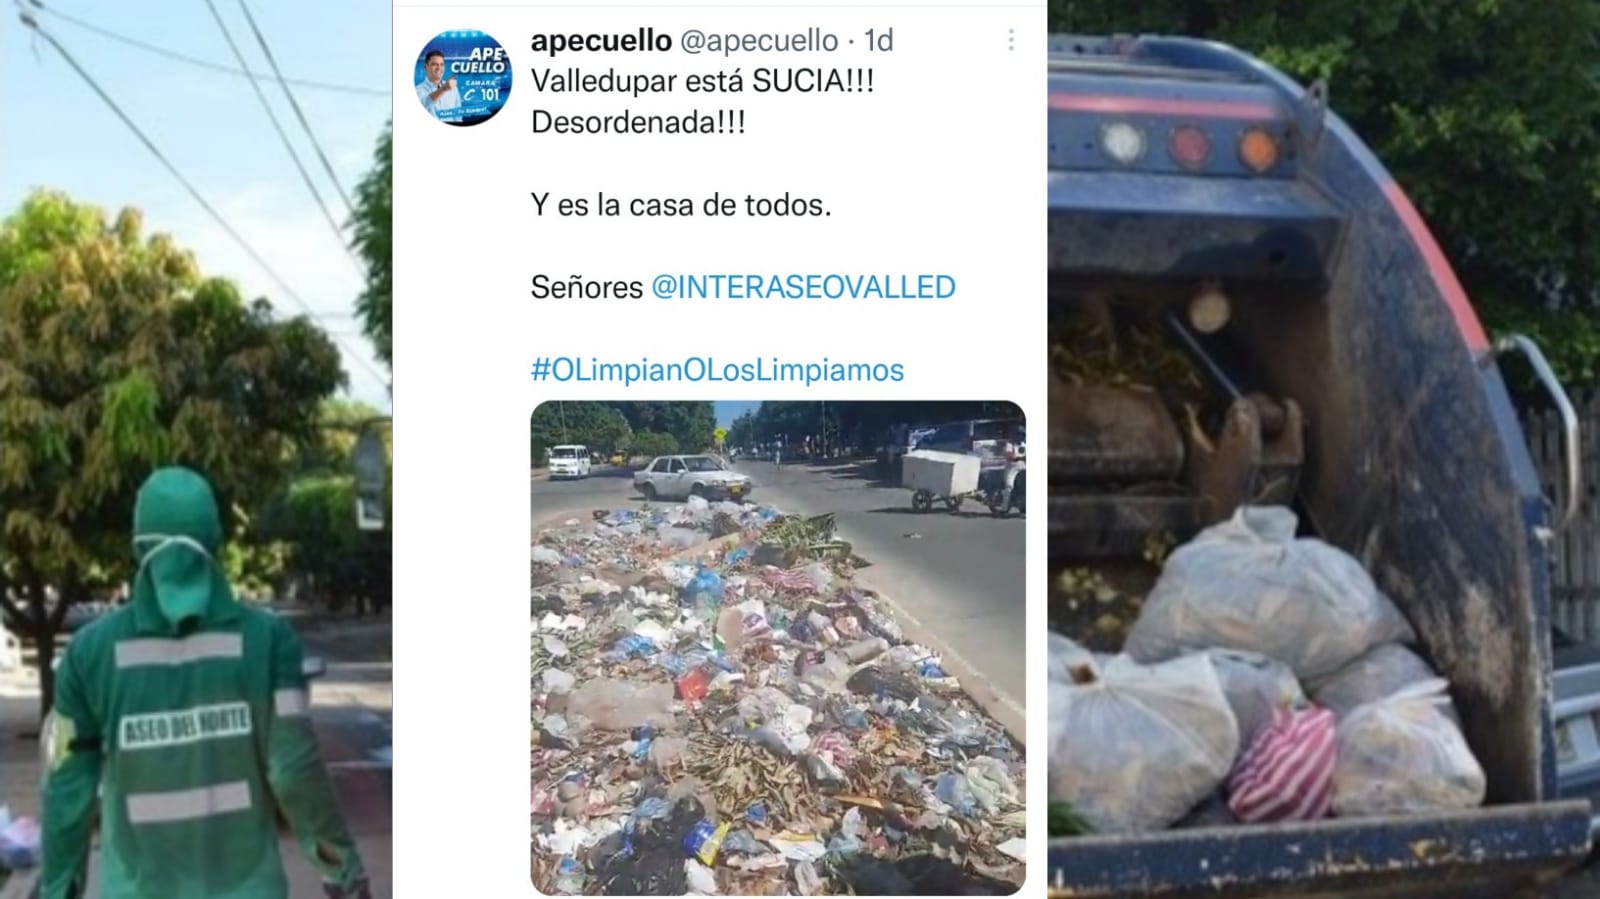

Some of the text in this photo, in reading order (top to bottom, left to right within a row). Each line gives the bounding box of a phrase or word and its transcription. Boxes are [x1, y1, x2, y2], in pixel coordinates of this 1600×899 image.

[451, 61, 505, 74] CUELLO
[481, 88, 500, 101] 101
[125, 717, 168, 742] ASEO
[200, 707, 248, 734] NORTE
